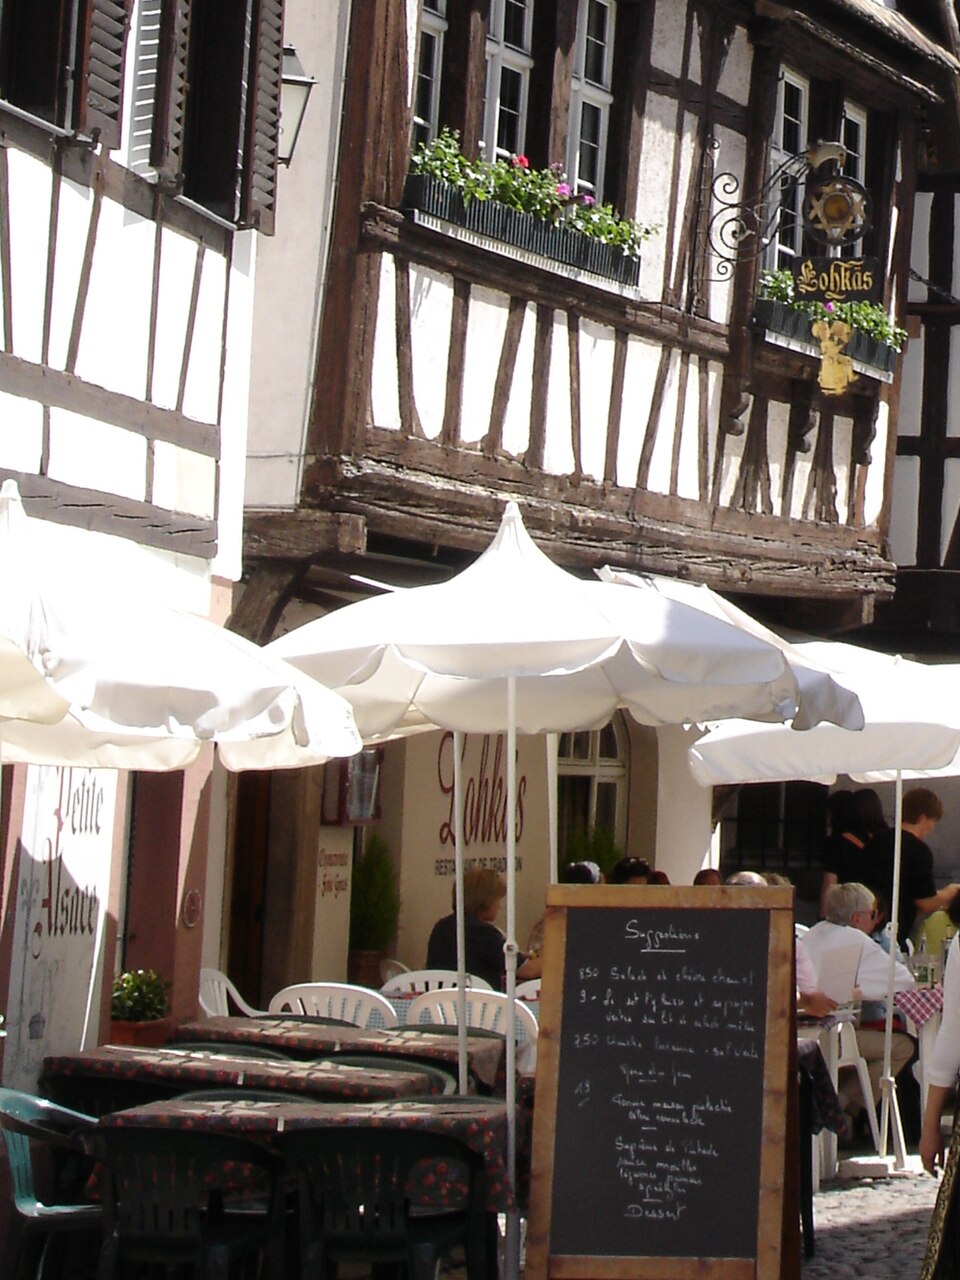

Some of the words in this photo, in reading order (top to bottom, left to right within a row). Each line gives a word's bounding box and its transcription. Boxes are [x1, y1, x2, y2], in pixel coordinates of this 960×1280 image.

[438, 731, 526, 846] Lohks
[31, 837, 98, 959] Alsace
[625, 919, 700, 949] Suggestions
[624, 1204, 686, 1220] Dessert
